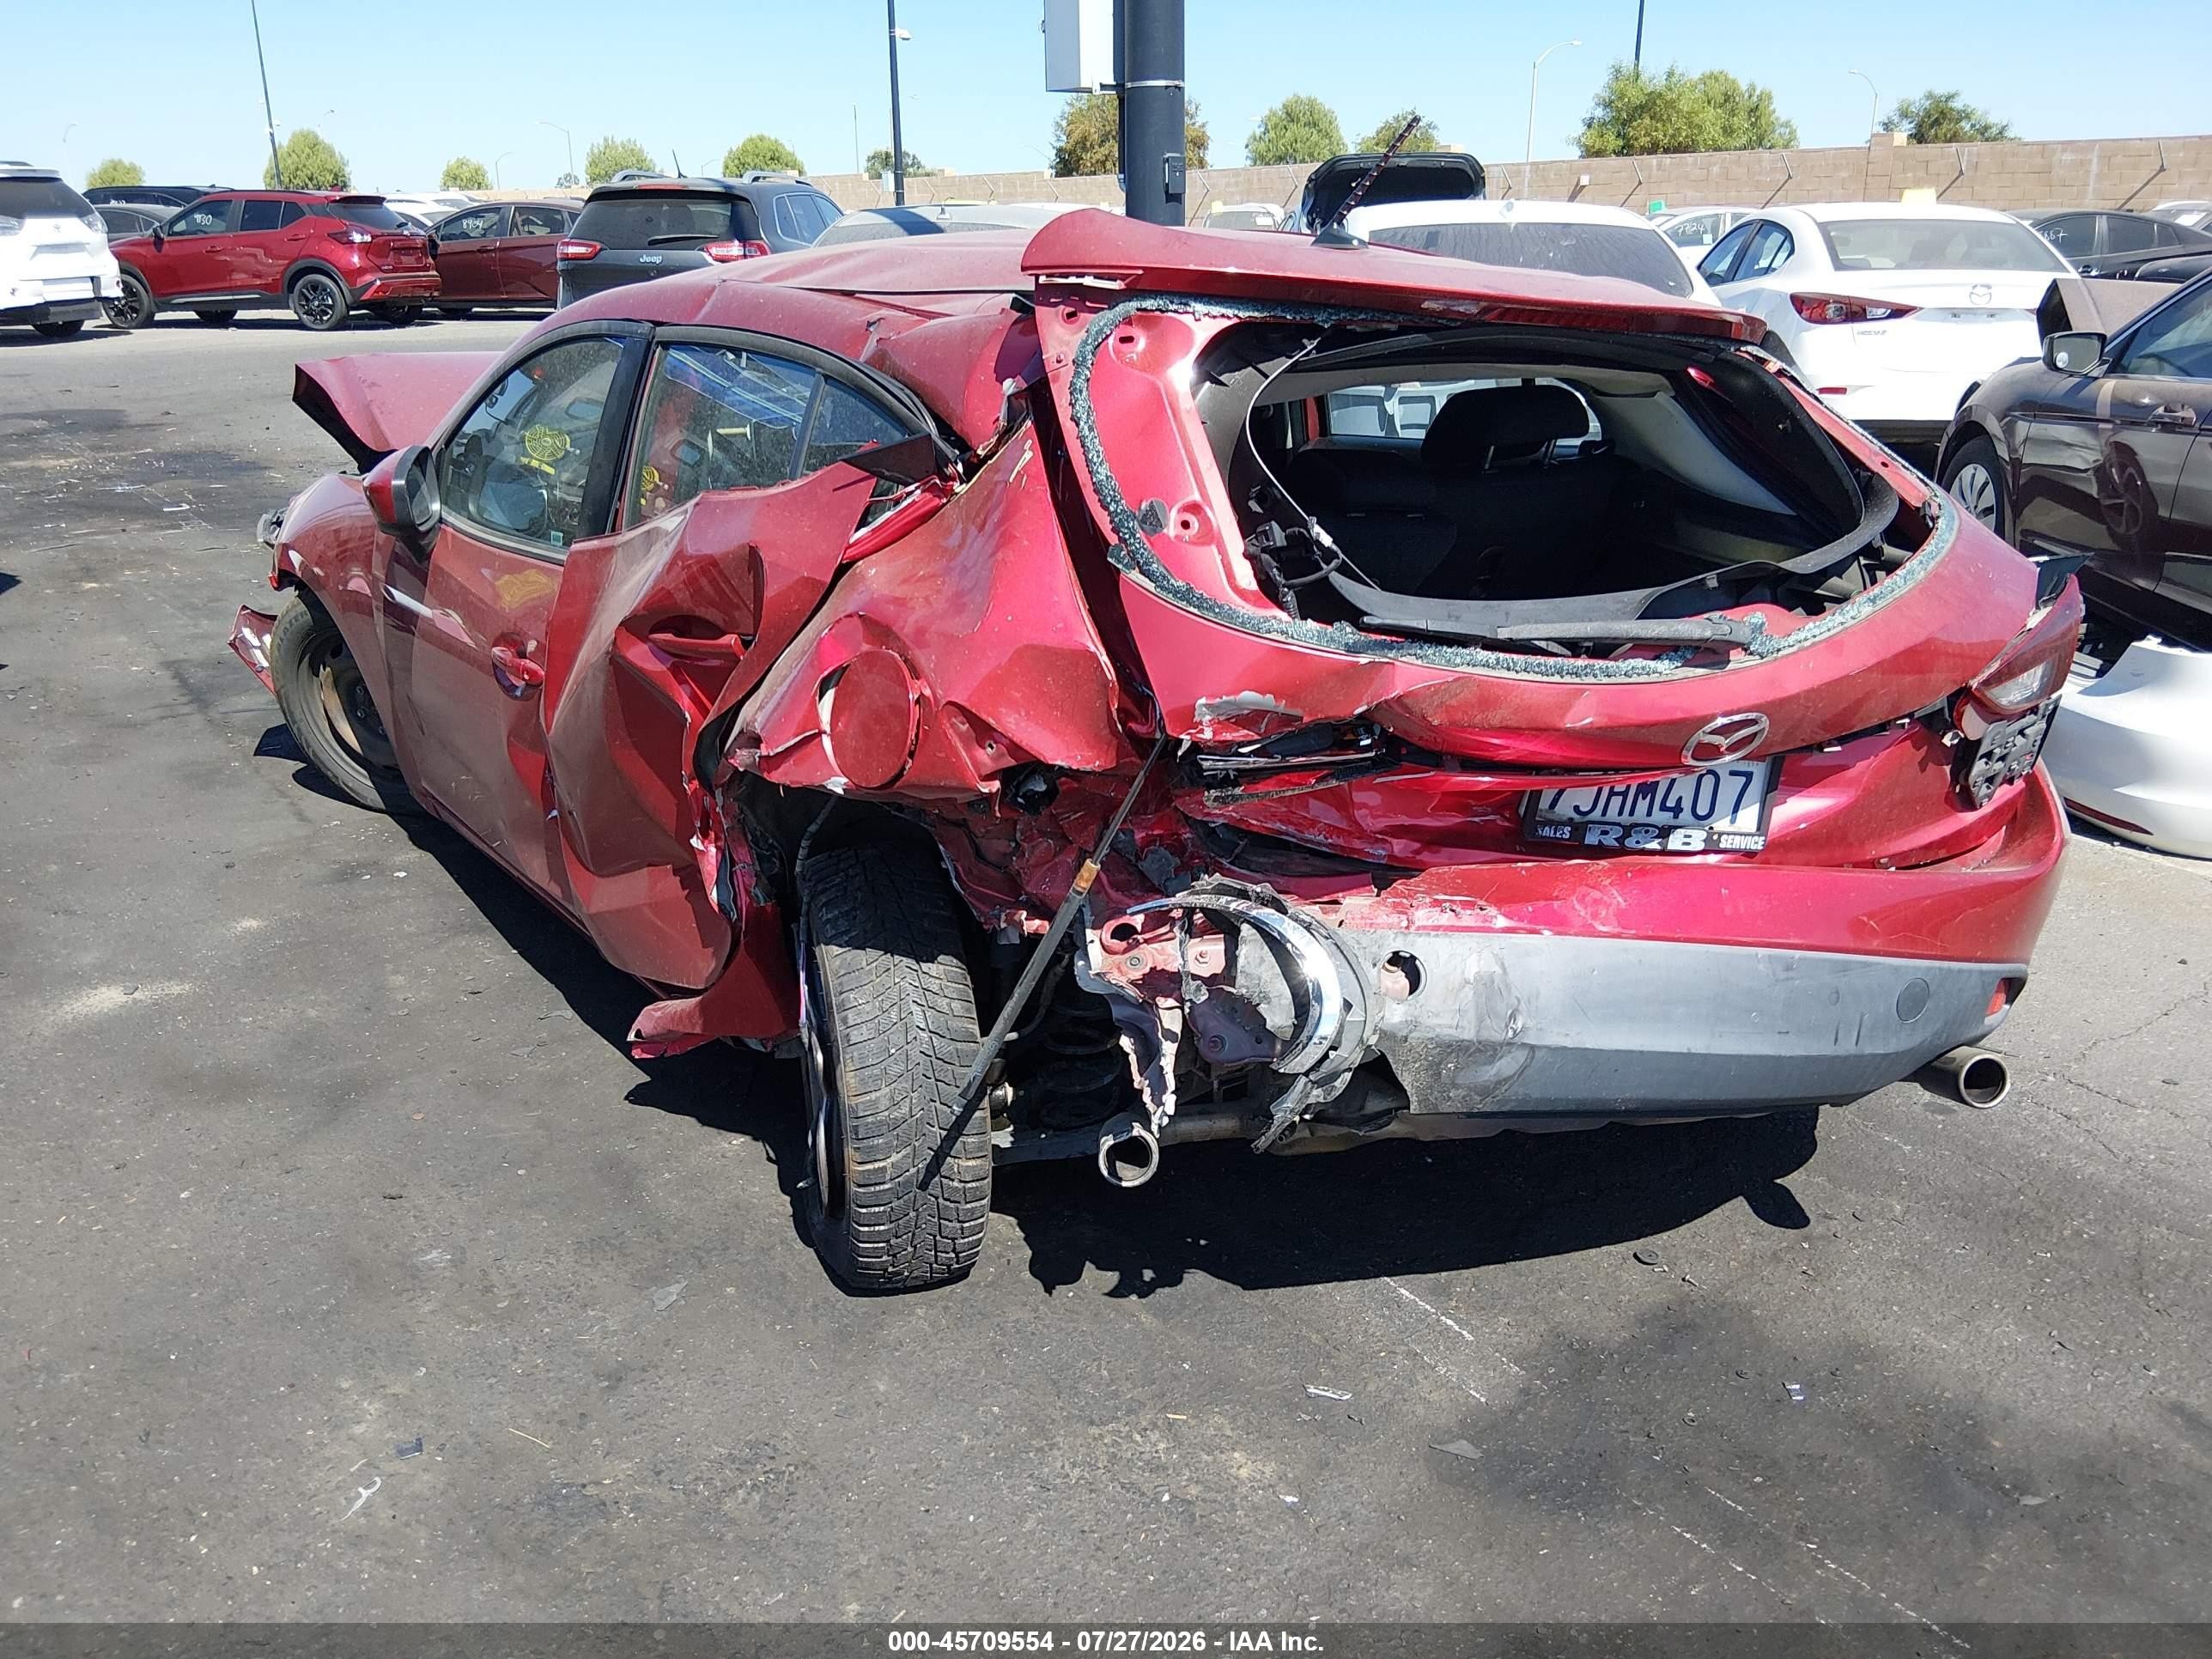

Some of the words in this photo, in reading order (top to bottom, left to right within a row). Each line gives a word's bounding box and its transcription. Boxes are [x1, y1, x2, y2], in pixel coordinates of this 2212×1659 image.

[639, 253, 662, 264] Jeep
[1536, 825, 1571, 839] SALES
[1583, 823, 1708, 851] R&B
[1719, 834, 1765, 849] SERVICE
